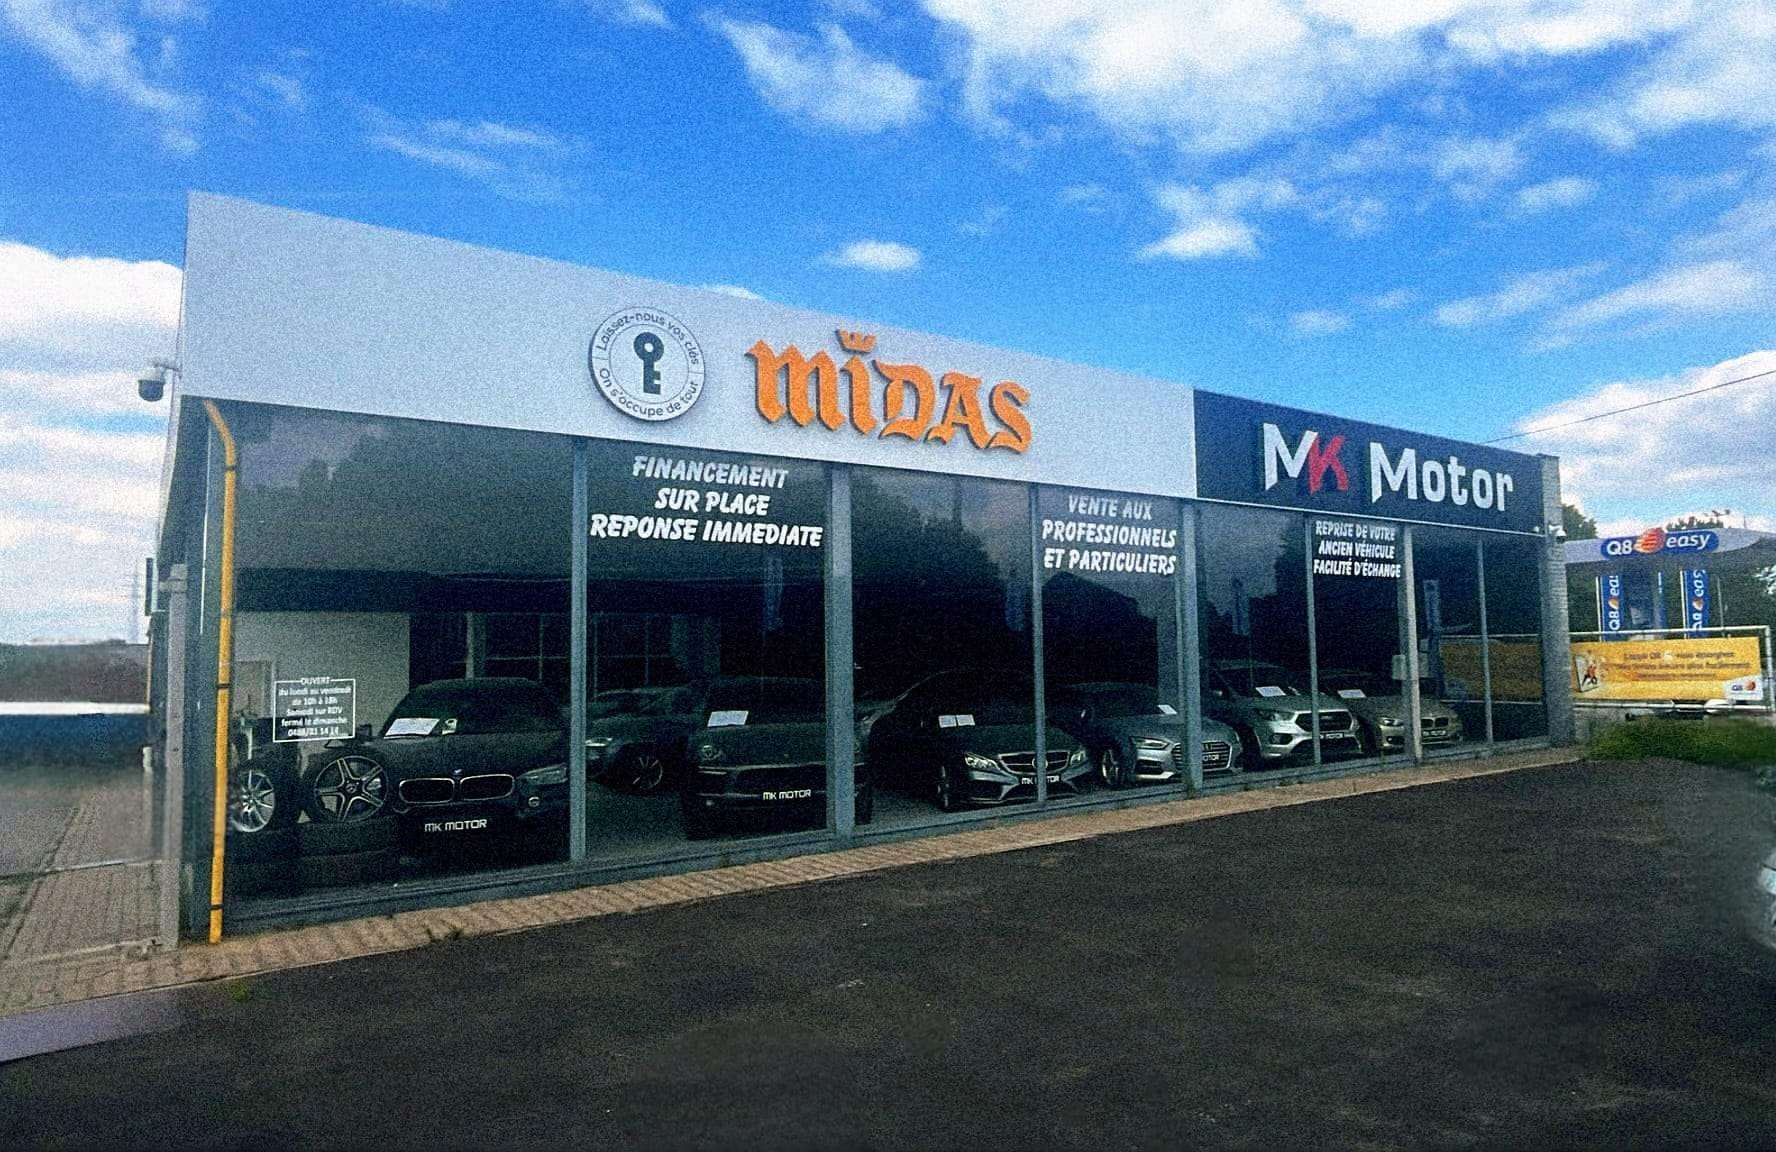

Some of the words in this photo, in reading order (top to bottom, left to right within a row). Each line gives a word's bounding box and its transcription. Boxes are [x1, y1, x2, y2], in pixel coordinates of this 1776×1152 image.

[596, 312, 665, 351] Laissez-nous
[667, 321, 685, 341] vos
[684, 341, 699, 365] clés
[599, 367, 613, 388] On
[611, 387, 664, 418] s'occupe
[666, 400, 682, 414] de
[681, 380, 699, 402] tout
[632, 455, 789, 489] FINANCEMENT
[1262, 422, 1350, 496] MK
[1369, 441, 1514, 512] Motor
[654, 487, 699, 513] SUR
[705, 491, 770, 516] PLACE
[1068, 494, 1118, 518] VENTE
[1122, 500, 1153, 521] AUX
[589, 513, 699, 541] REPONSE
[702, 519, 824, 547] IMMEDIATE
[1041, 518, 1177, 548] PROFESSIONNELS
[1315, 520, 1355, 538] REPRISE
[1355, 523, 1368, 539] DE
[1369, 524, 1396, 541] VOTRE
[1318, 540, 1353, 556] ANCIEN
[1354, 540, 1395, 559] VÉHICULE
[1606, 539, 1633, 556] Q8
[1665, 533, 1711, 550] easy
[1043, 547, 1065, 569] ET
[1067, 548, 1177, 576] PARTICULIERS
[1608, 575, 1620, 597] ea
[1608, 610, 1621, 631] Q8
[300, 676, 330, 685] OUVERT
[763, 791, 777, 801] MK
[778, 788, 812, 800] MOTOR
[424, 822, 443, 833] MK
[445, 818, 488, 831] MOTOR
